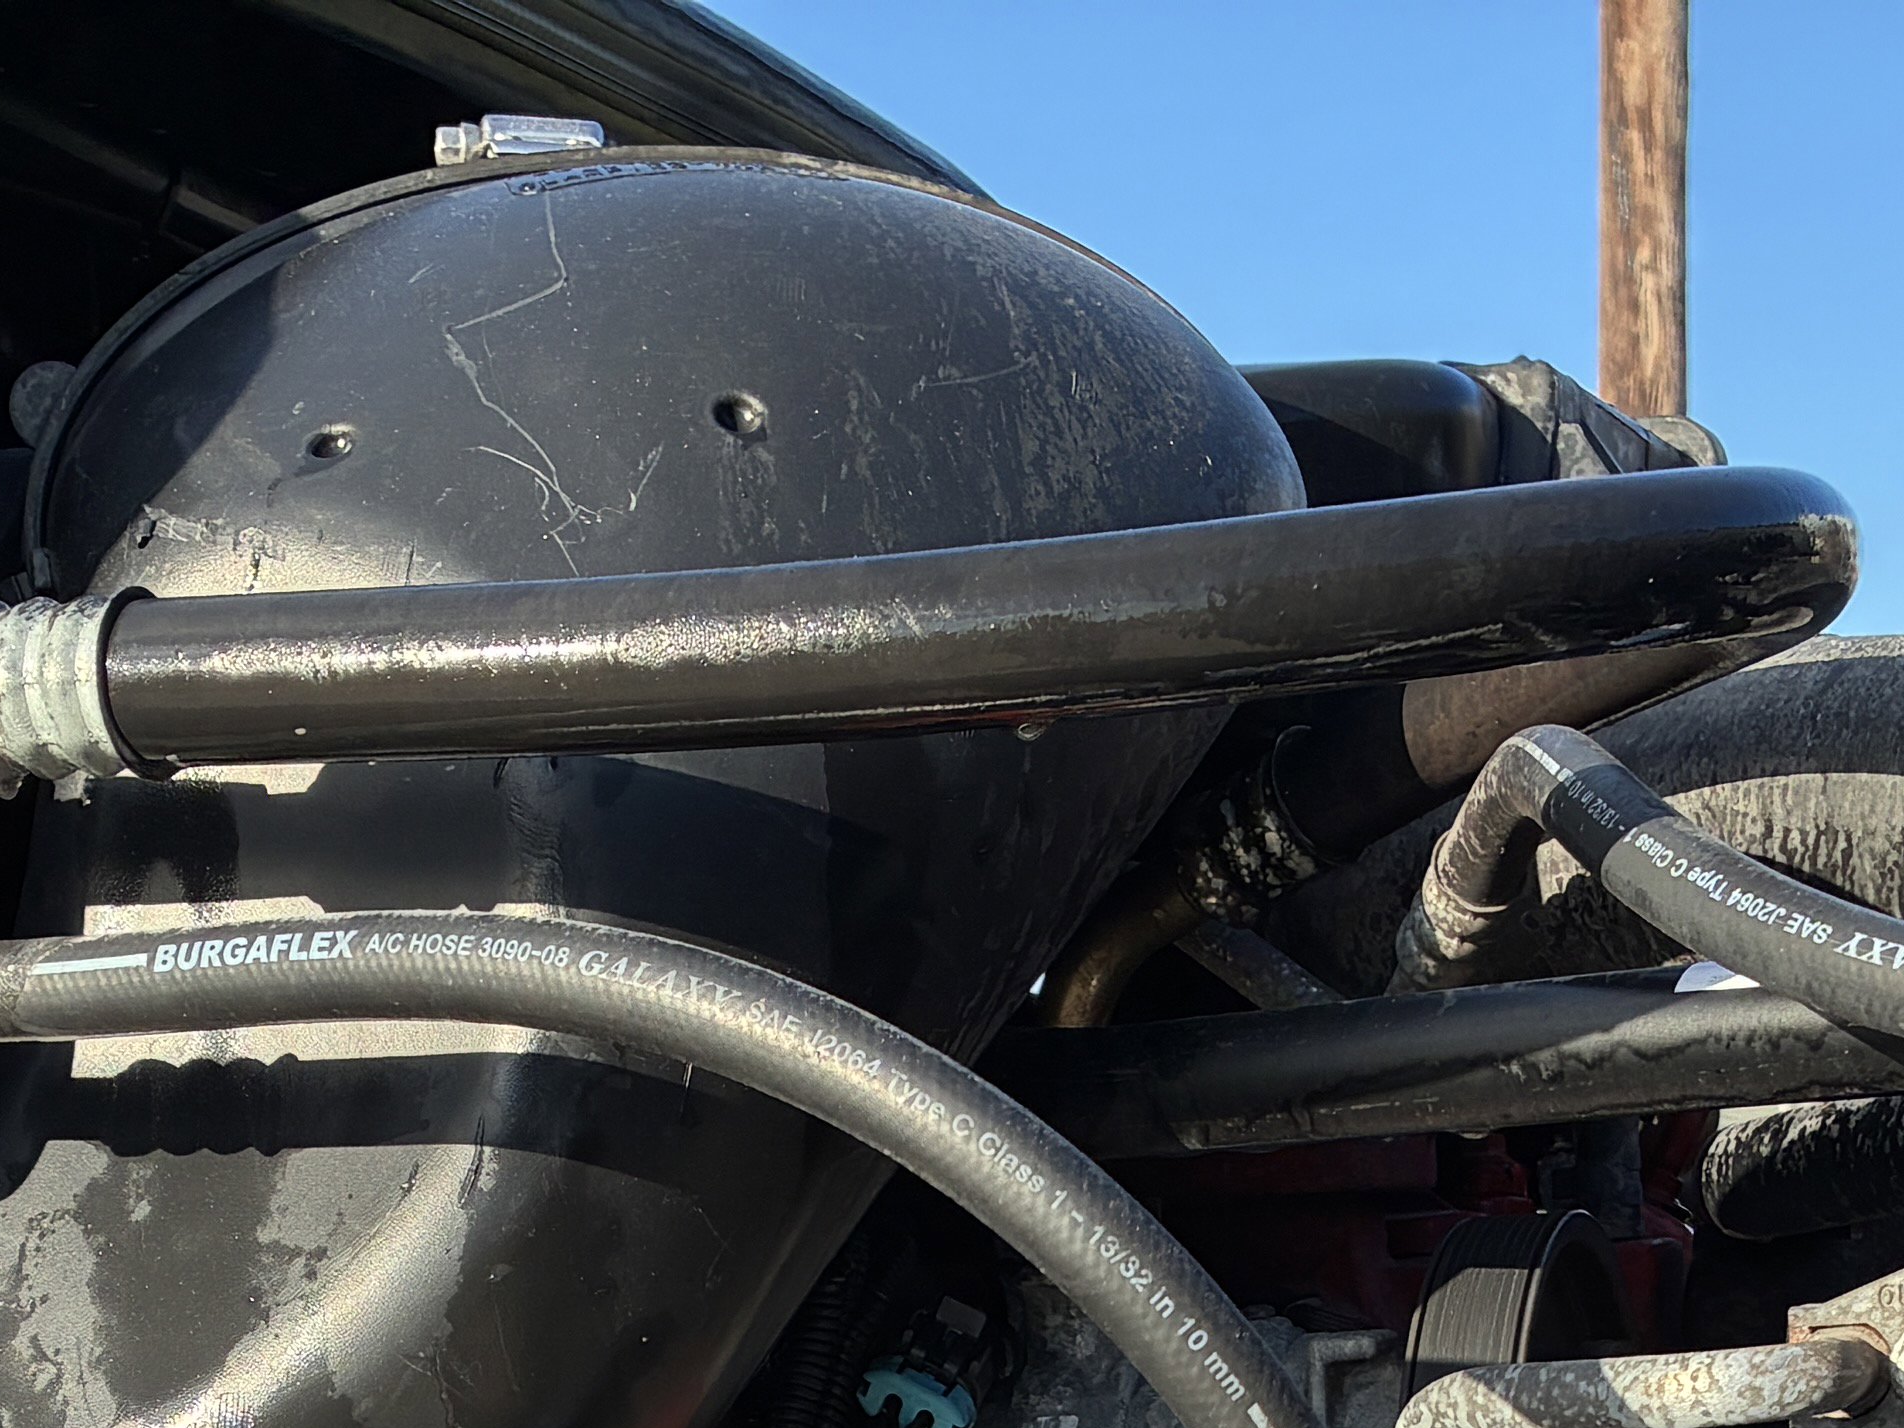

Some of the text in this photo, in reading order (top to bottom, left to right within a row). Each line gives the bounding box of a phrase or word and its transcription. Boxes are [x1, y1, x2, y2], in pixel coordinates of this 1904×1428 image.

[1634, 835, 1675, 869] Class
[1669, 858, 1689, 878] C
[1686, 866, 1729, 902] Type
[1725, 891, 1789, 926] J2064
[1782, 911, 1835, 946] SAE
[152, 929, 358, 973] BURGAFLEX
[364, 930, 404, 956] A/C
[409, 933, 477, 957] HOSE
[477, 937, 570, 968] 3090-08
[578, 949, 742, 1010] GALAXY
[886, 1067, 947, 1122] Type
[951, 1112, 976, 1138] C
[977, 1130, 1047, 1195] Class
[1050, 1189, 1069, 1211] 1
[1087, 1224, 1154, 1294] 13/32
[1176, 1316, 1210, 1353] 10
[1203, 1350, 1248, 1403] mm
